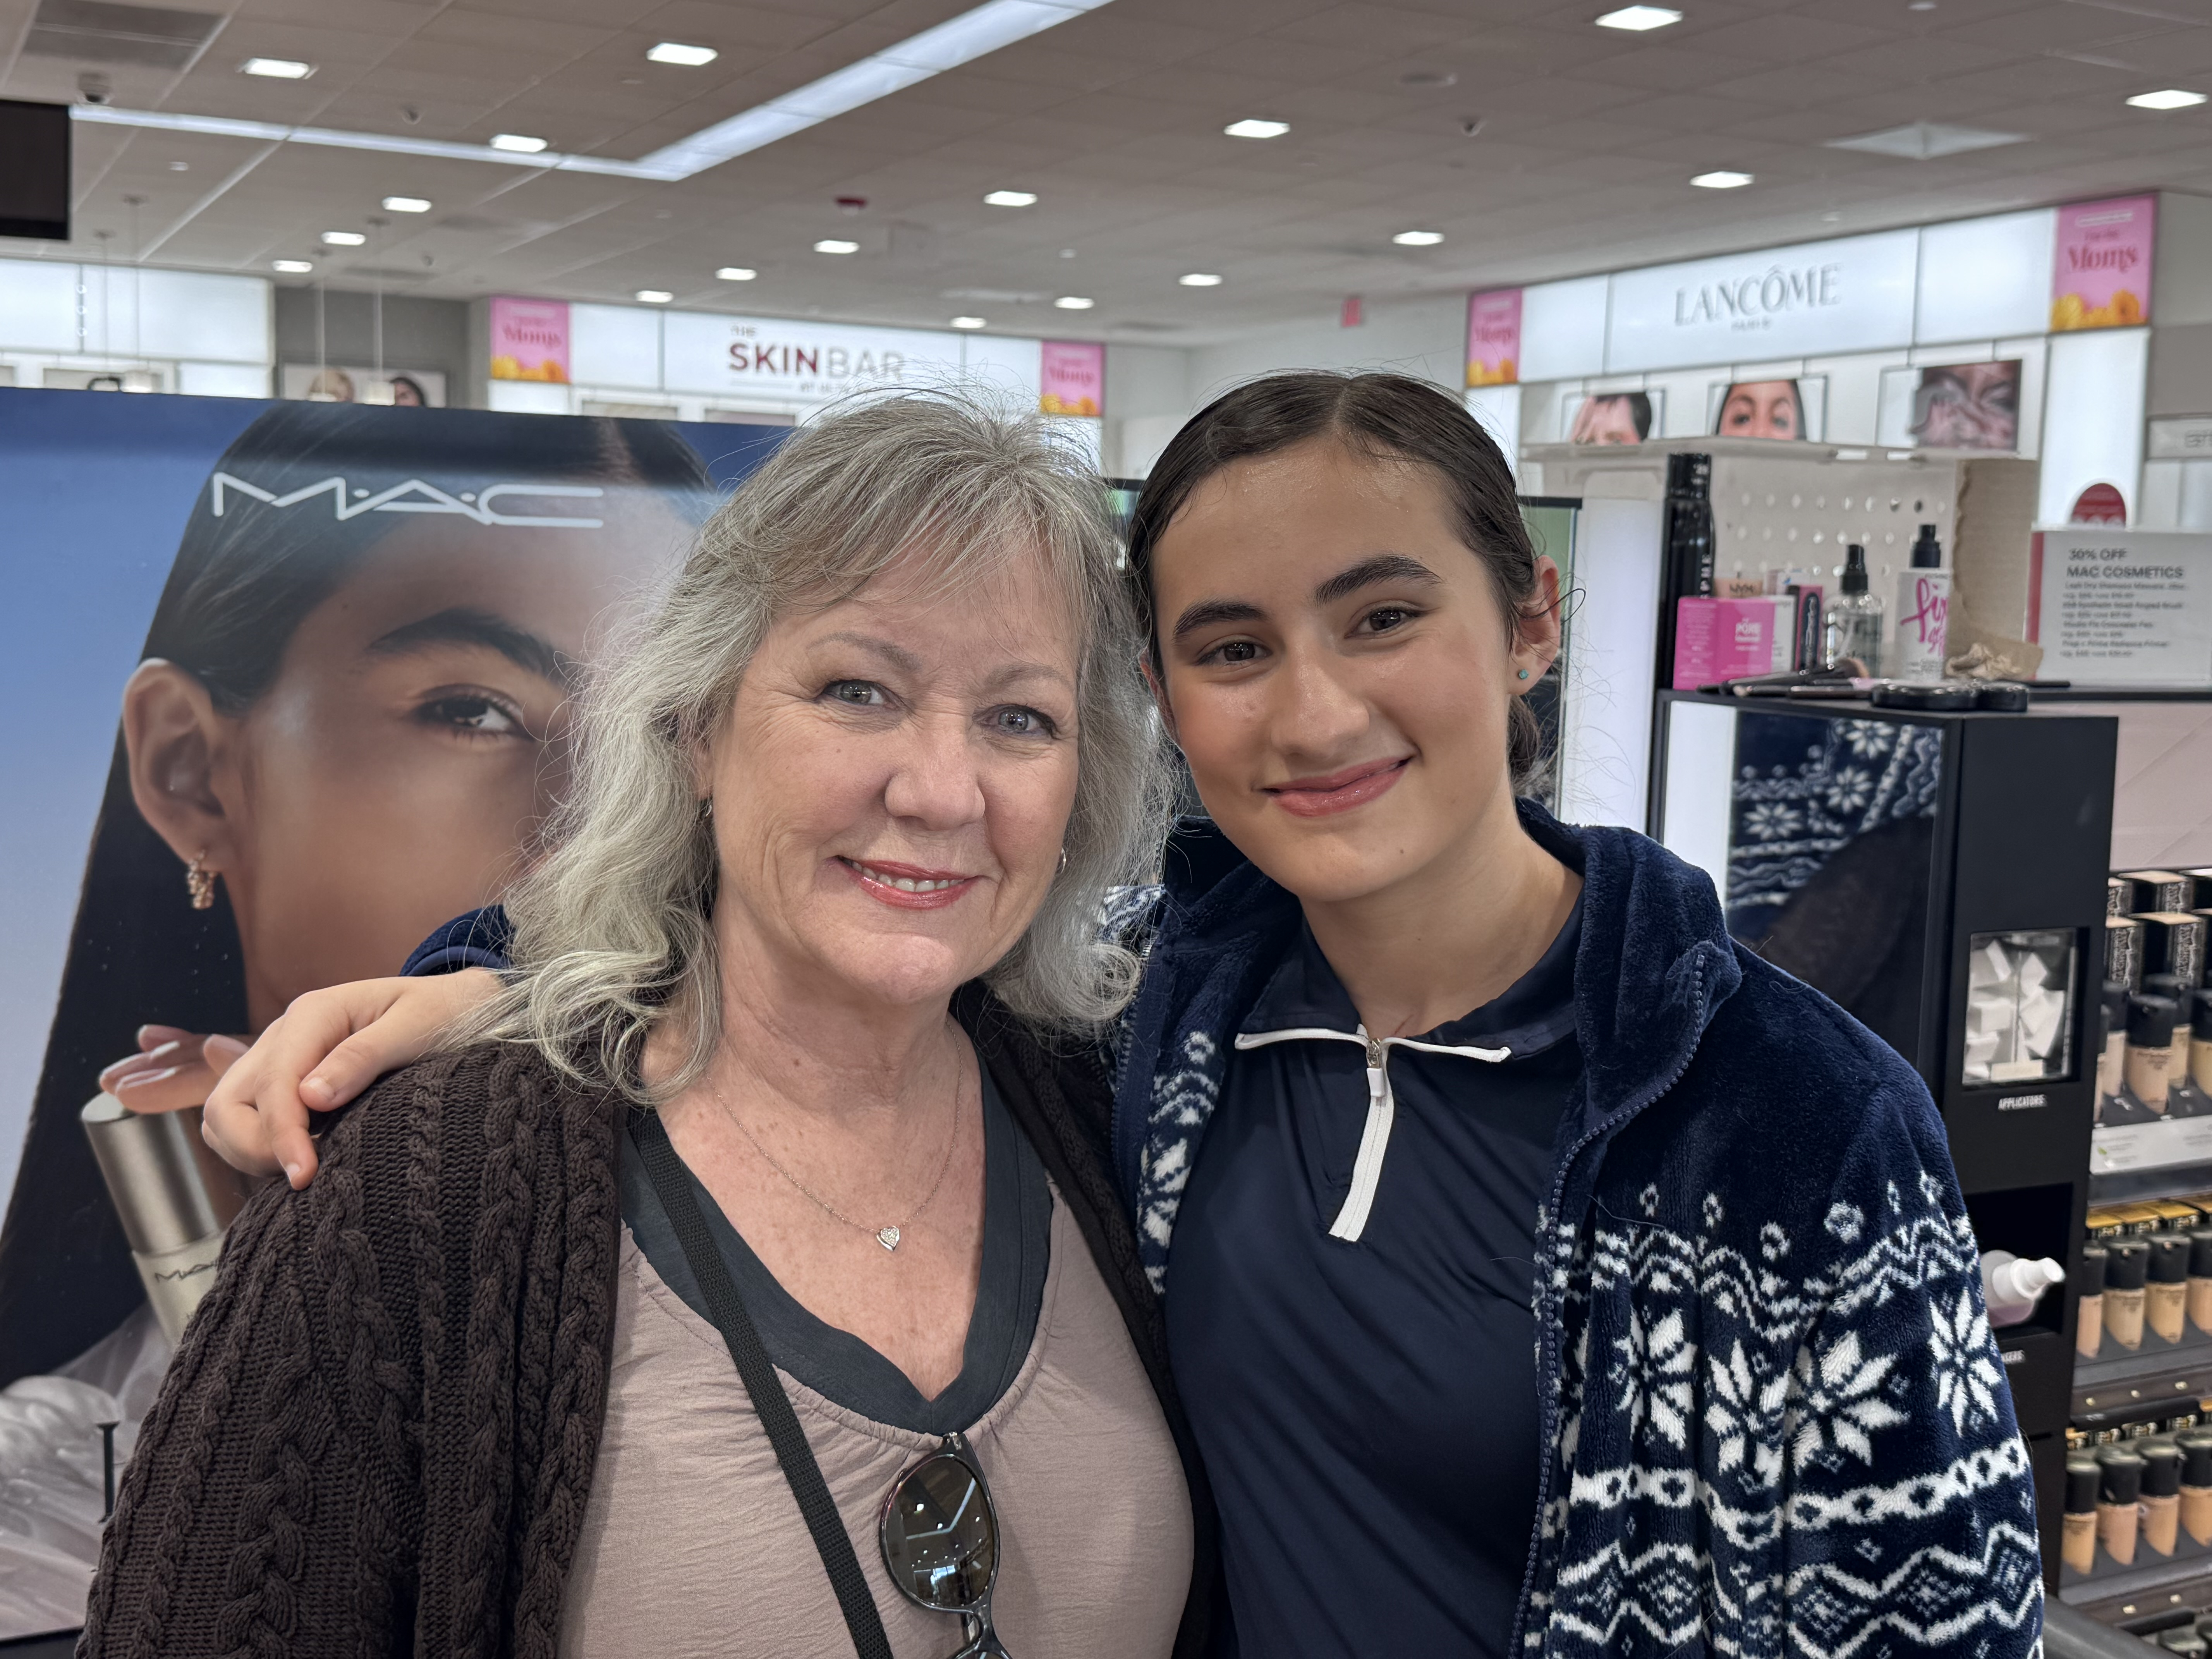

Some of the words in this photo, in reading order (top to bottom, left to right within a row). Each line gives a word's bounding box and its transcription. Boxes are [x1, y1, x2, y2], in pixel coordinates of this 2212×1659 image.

[1675, 263, 1843, 326] LANCÔME
[731, 325, 756, 337] THE
[2100, 548, 2128, 561] OFF
[2066, 565, 2100, 578] MAC
[2103, 565, 2185, 579] COSMETICS
[1998, 1094, 2047, 1111] APPLICATORS
